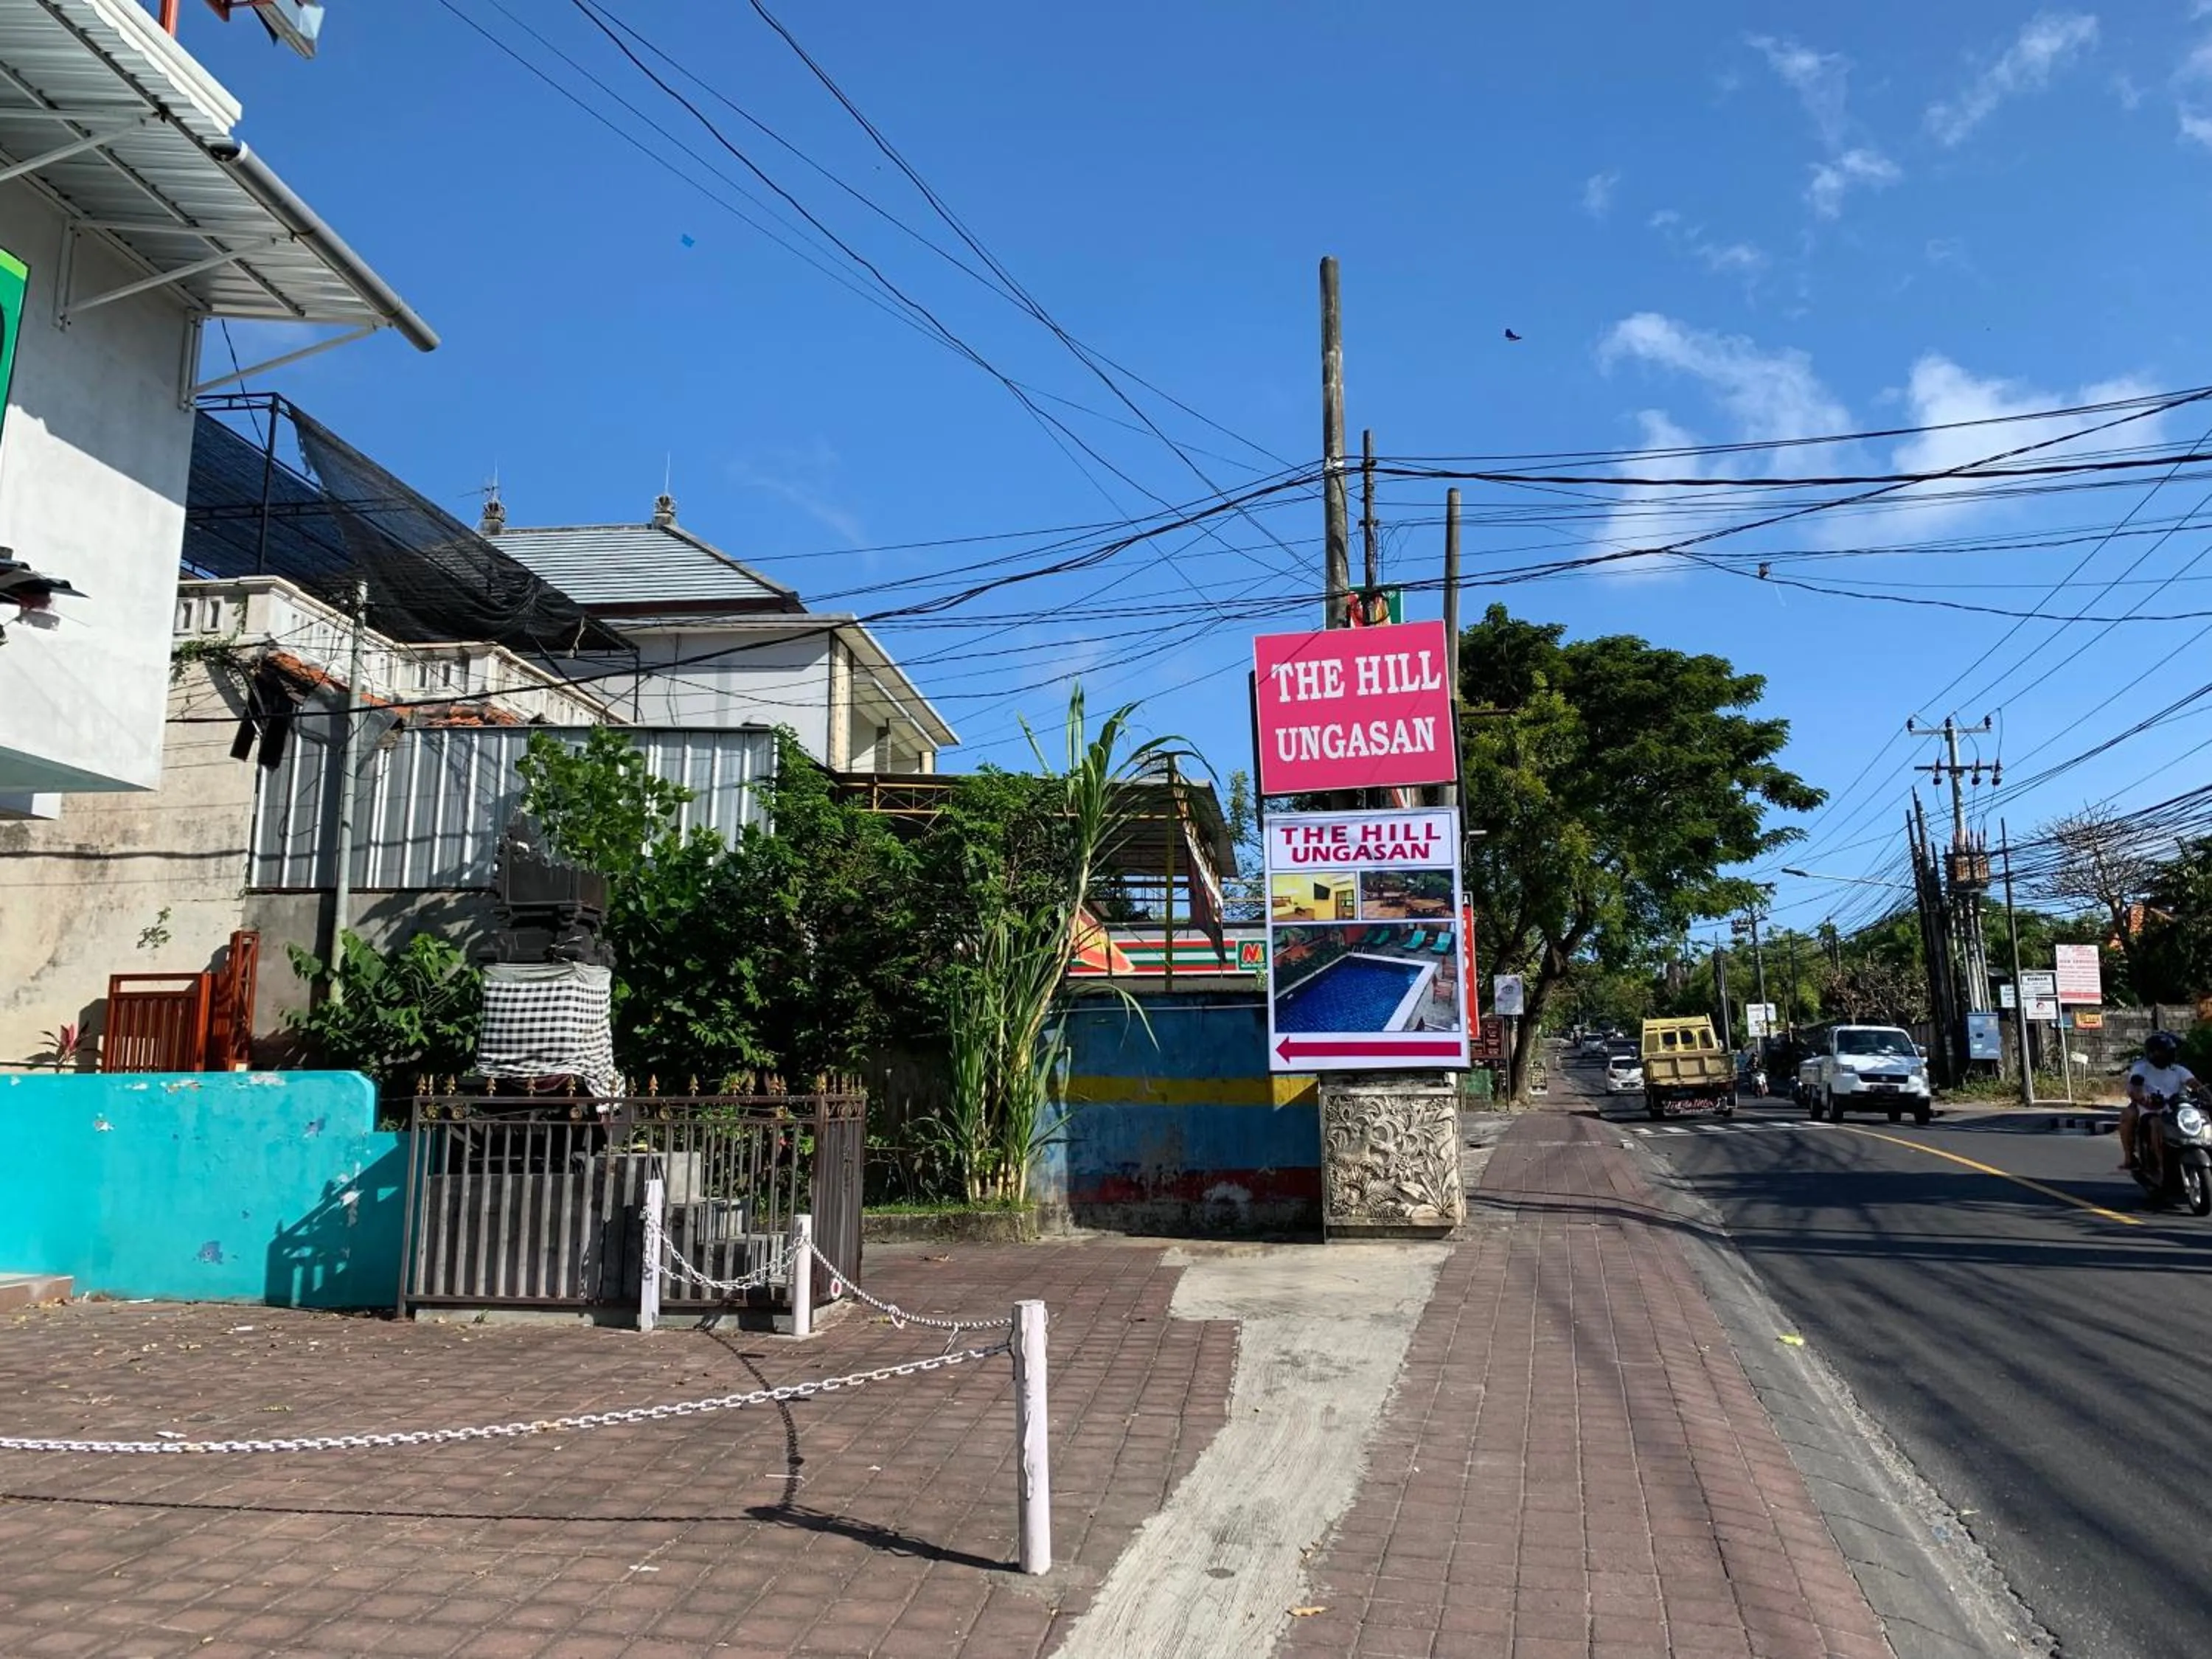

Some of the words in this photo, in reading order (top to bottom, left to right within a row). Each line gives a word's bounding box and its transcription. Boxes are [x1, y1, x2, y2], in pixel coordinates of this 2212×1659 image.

[1270, 658, 1345, 703] THE
[1355, 650, 1441, 696] HILL
[1275, 716, 1436, 762] UNGASAN
[1279, 825, 1348, 846] THE
[1360, 822, 1441, 842] HILL
[1291, 842, 1430, 863] UNGASAN
